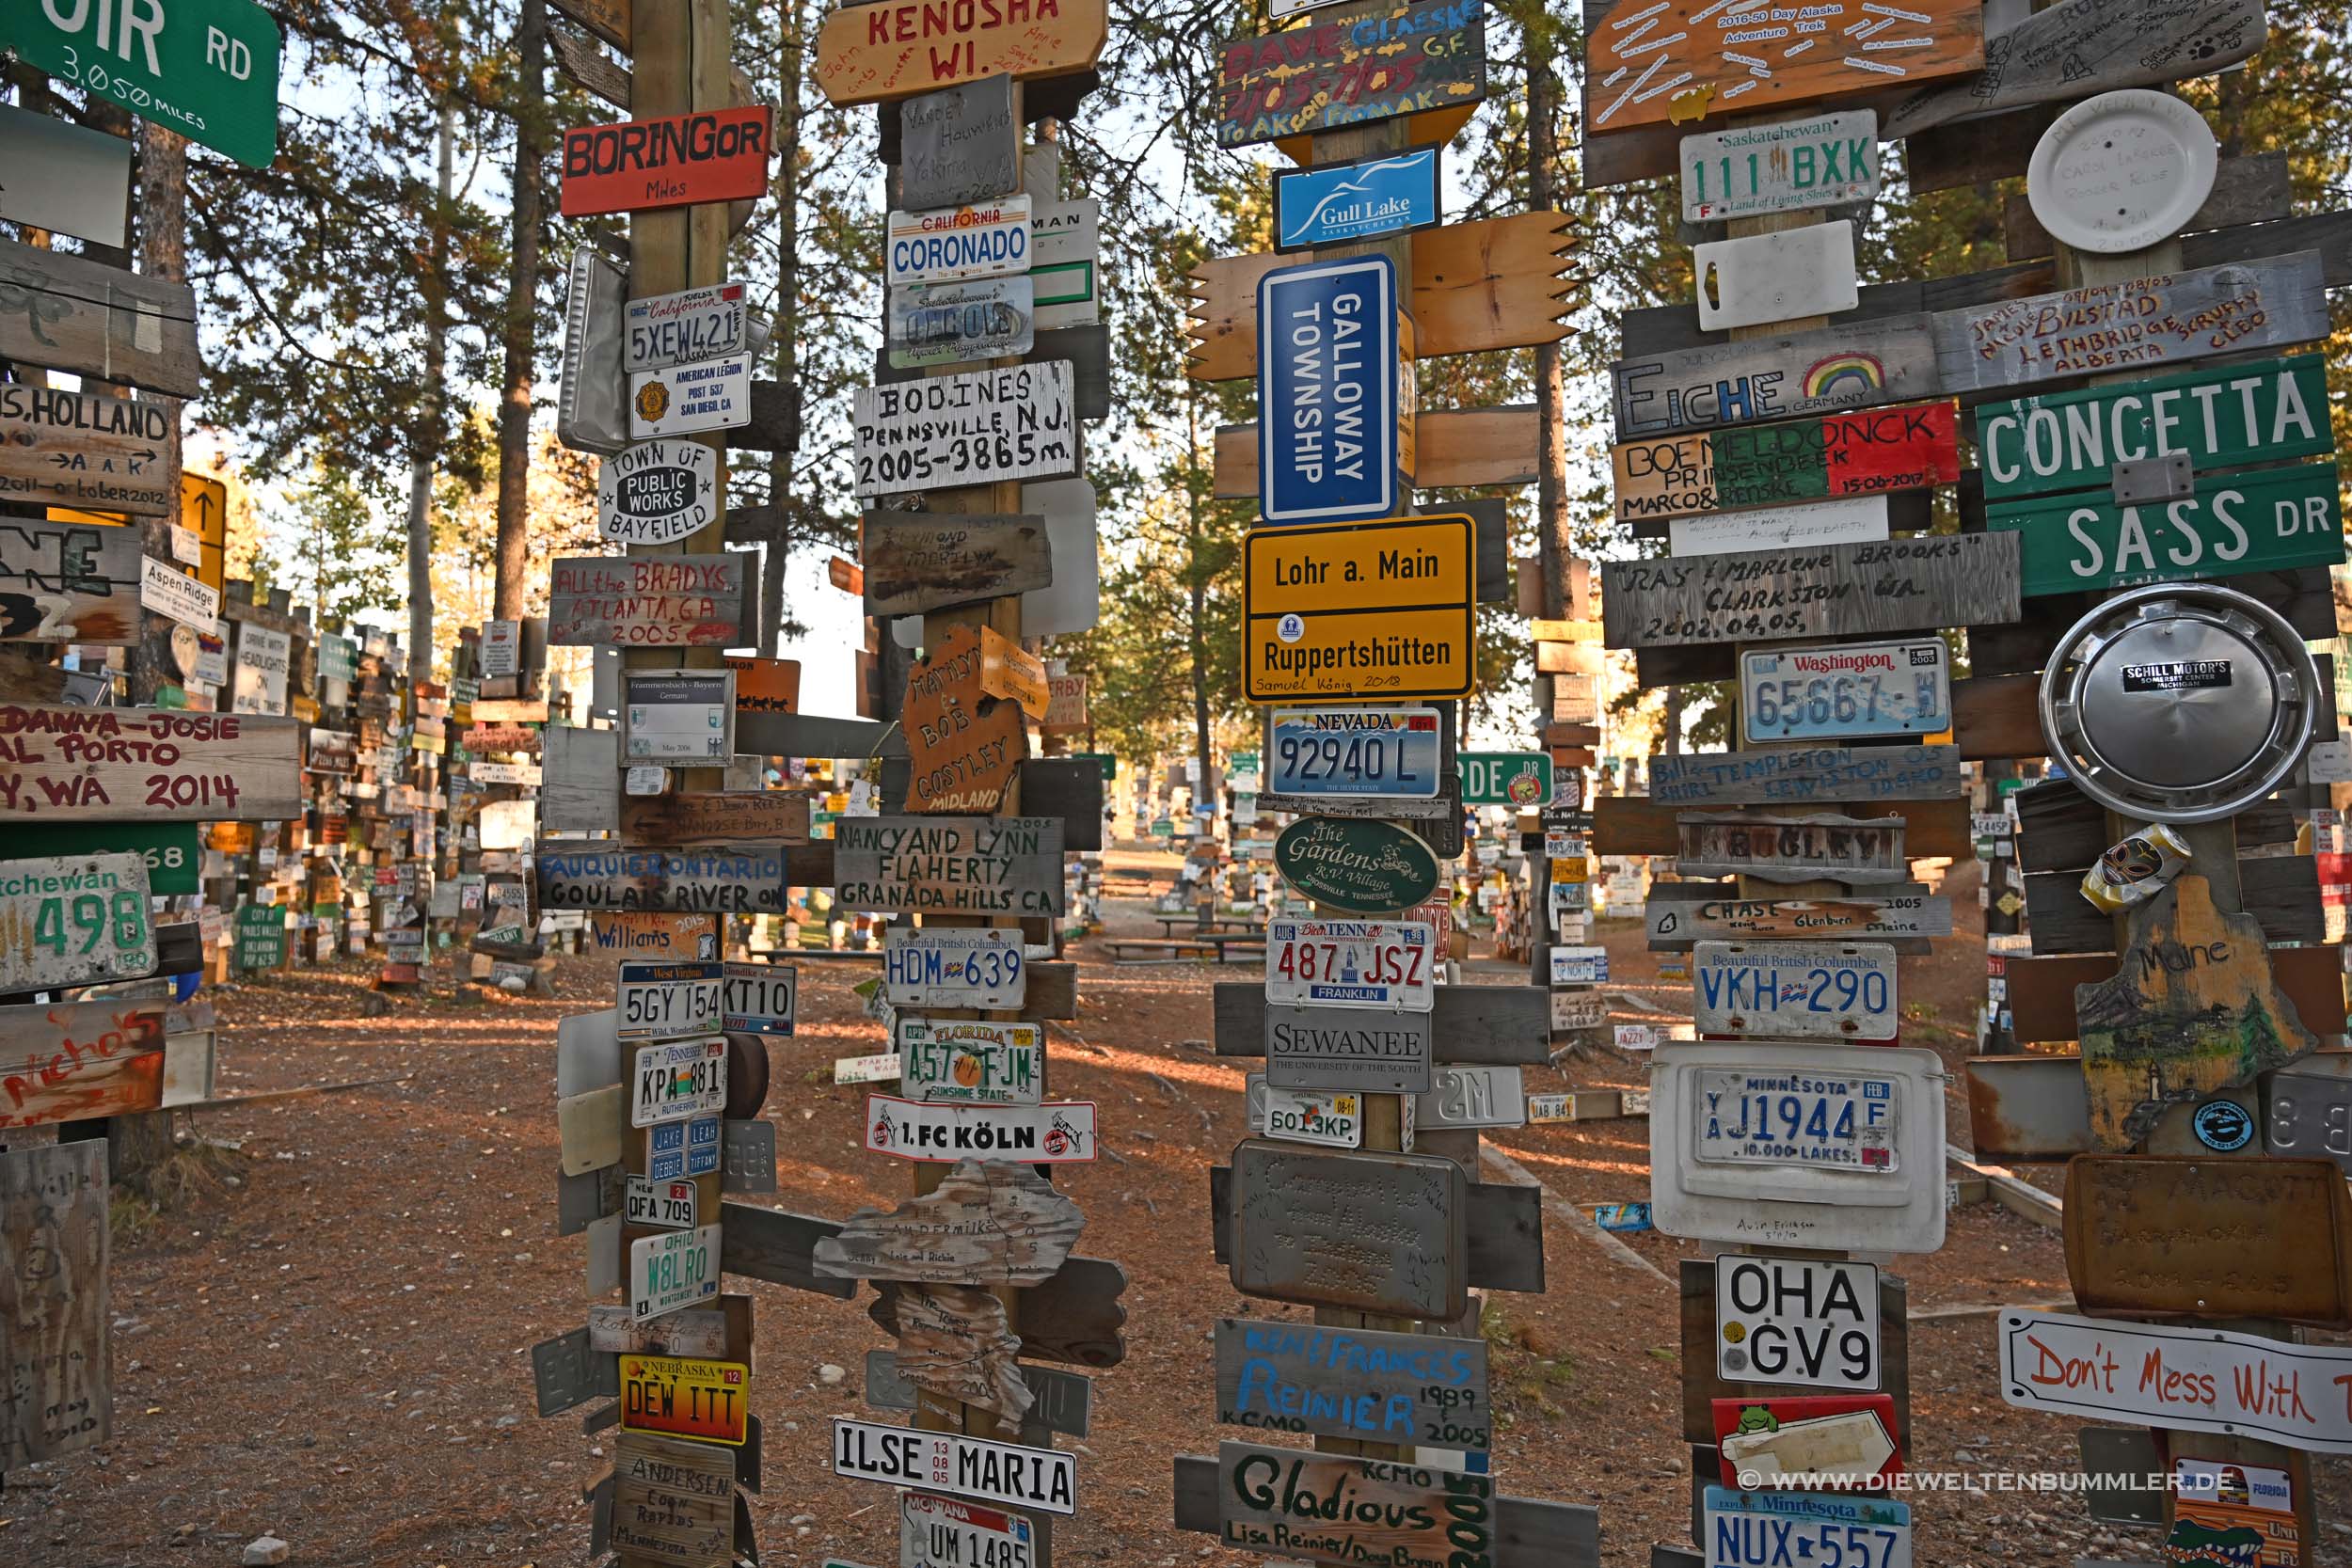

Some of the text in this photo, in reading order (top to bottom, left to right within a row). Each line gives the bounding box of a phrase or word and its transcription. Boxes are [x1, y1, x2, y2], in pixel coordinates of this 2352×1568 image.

[1772, 5, 1841, 22] Day Alaska
[1724, 22, 1824, 43] Adventure Trek
[206, 25, 251, 81] RD
[155, 99, 206, 130] MILES
[1723, 120, 1832, 149] Saskatchewan
[1793, 136, 1870, 188] BXK
[1321, 197, 1410, 226] Gull Lake
[1729, 193, 1804, 212] Land Living
[922, 209, 1000, 230] CALIFORNIA
[894, 226, 1025, 273] CORONADO
[676, 363, 742, 385] AMERICAN LEGION
[688, 384, 723, 401] POST 537
[1292, 301, 1323, 483] TOWNSHIP
[1332, 293, 1363, 482] GALLOWAY
[681, 403, 700, 415] SAN
[721, 399, 732, 411] CA
[1793, 390, 1866, 414] GERMANY
[1986, 370, 2316, 483] CONCETTA
[610, 444, 706, 478] TOWN OF
[627, 470, 686, 496] PUBLIC
[629, 490, 684, 513] WORKS
[609, 504, 706, 539] BAYFIELD
[2067, 489, 2330, 578] SASS DR
[1276, 549, 1438, 587] Lohr a. Main
[148, 565, 213, 607] Aspen Ridge
[246, 632, 286, 651] DRIVE WITH
[241, 653, 287, 673] HEADLIGHTS
[1264, 637, 1451, 677] Ruppertshütten
[1794, 652, 1896, 673] Washington
[2127, 660, 2226, 678] SCHILL MOTOR'S
[2140, 673, 2215, 685] SOMERSET CENTER
[256, 674, 268, 689] ON
[1364, 674, 1401, 688] 2018
[2157, 680, 2201, 689] MICHIGAN
[237, 695, 247, 707] AT
[920, 707, 970, 749] BOB
[1315, 713, 1393, 731] NEVADA
[56, 734, 180, 767] PORTO
[1279, 737, 1384, 781] 92940
[1523, 761, 1539, 776] DR
[145, 774, 240, 809] 2014
[976, 829, 1039, 855] LYNN
[1313, 825, 1343, 842] The
[1289, 837, 1382, 872] Gardens
[541, 855, 779, 880] FAUQUIER ONTARIO
[879, 855, 1013, 884] FLAHERTY
[1306, 874, 1346, 896] CROSSVILLE
[1347, 872, 1391, 891] Village
[840, 882, 946, 909] GRANADA
[1701, 901, 1779, 920] CHASE
[1794, 912, 1852, 928] Glenburn
[35, 892, 147, 956] 498
[594, 921, 670, 949] Williams
[1276, 927, 1293, 940] AUG
[897, 938, 1011, 950] Beautiful British Columbia
[888, 947, 1021, 988] HDM 639
[1278, 942, 1423, 986] 487 JSZ
[1712, 954, 1878, 969] Beautiful British Columbia
[1318, 988, 1379, 1000] FRANKLIN
[1700, 966, 1887, 1013] VKH 290
[933, 1025, 1006, 1045] FLORIDA
[664, 1046, 702, 1064] TENNESSEE
[1276, 1061, 1422, 1074] THE UNIVERSITY OF THE SOUTH
[642, 1059, 719, 1105] KPA 881
[1746, 1078, 1848, 1094] MINNESOTA
[931, 1086, 1009, 1101] SUNSHINE STATE
[658, 1132, 680, 1148] JAKE
[692, 1126, 715, 1142] LEAH
[955, 1121, 1035, 1149] KÖLN
[691, 1149, 717, 1168] TIFFANY
[1801, 1146, 1850, 1162] LAKES
[654, 1160, 681, 1179] DEBBIE
[663, 1199, 691, 1222] 709
[664, 1234, 694, 1250] OHIO
[1731, 1263, 1866, 1322] OHA
[1327, 1335, 1472, 1386] FRANCES
[1751, 1324, 1871, 1381] GV9
[651, 1361, 715, 1377] NEBRASKA
[2027, 1334, 2316, 1424] Don't Mess With
[933, 1441, 948, 1453] 13
[1424, 1423, 1490, 1449] 2005
[839, 1427, 1071, 1506] ILSE MARIA
[932, 1456, 948, 1468] 08
[932, 1471, 948, 1483] 05
[1234, 1454, 1436, 1530] Gladious
[2253, 1483, 2288, 1498] FLORIDA
[906, 1496, 970, 1521] MONTANA
[1762, 1496, 1856, 1518] Minnesota
[1716, 1516, 1793, 1568] NUX
